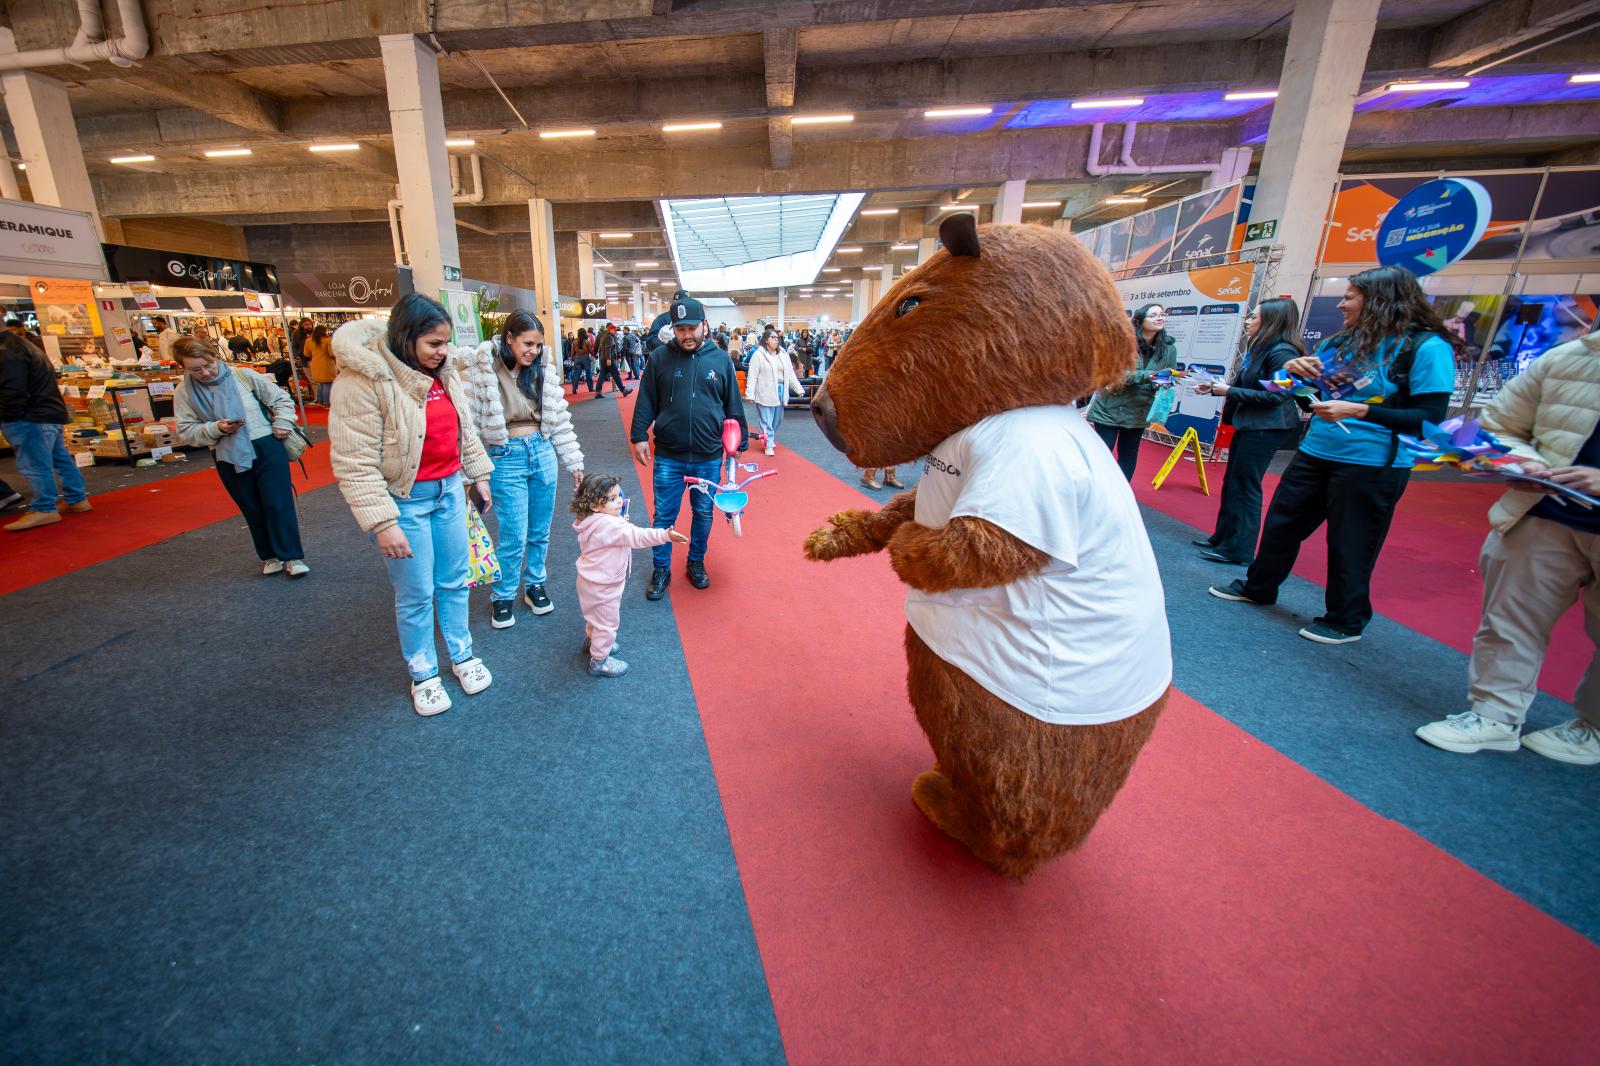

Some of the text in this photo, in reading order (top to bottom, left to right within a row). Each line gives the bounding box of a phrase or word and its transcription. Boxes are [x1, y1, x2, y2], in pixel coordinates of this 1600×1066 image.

[1427, 222, 1441, 230] SUA
[328, 282, 346, 290] LOJA
[349, 276, 393, 304] Oxford
[1140, 292, 1147, 300] 13
[1147, 291, 1156, 299] de
[1156, 288, 1192, 298] setembro
